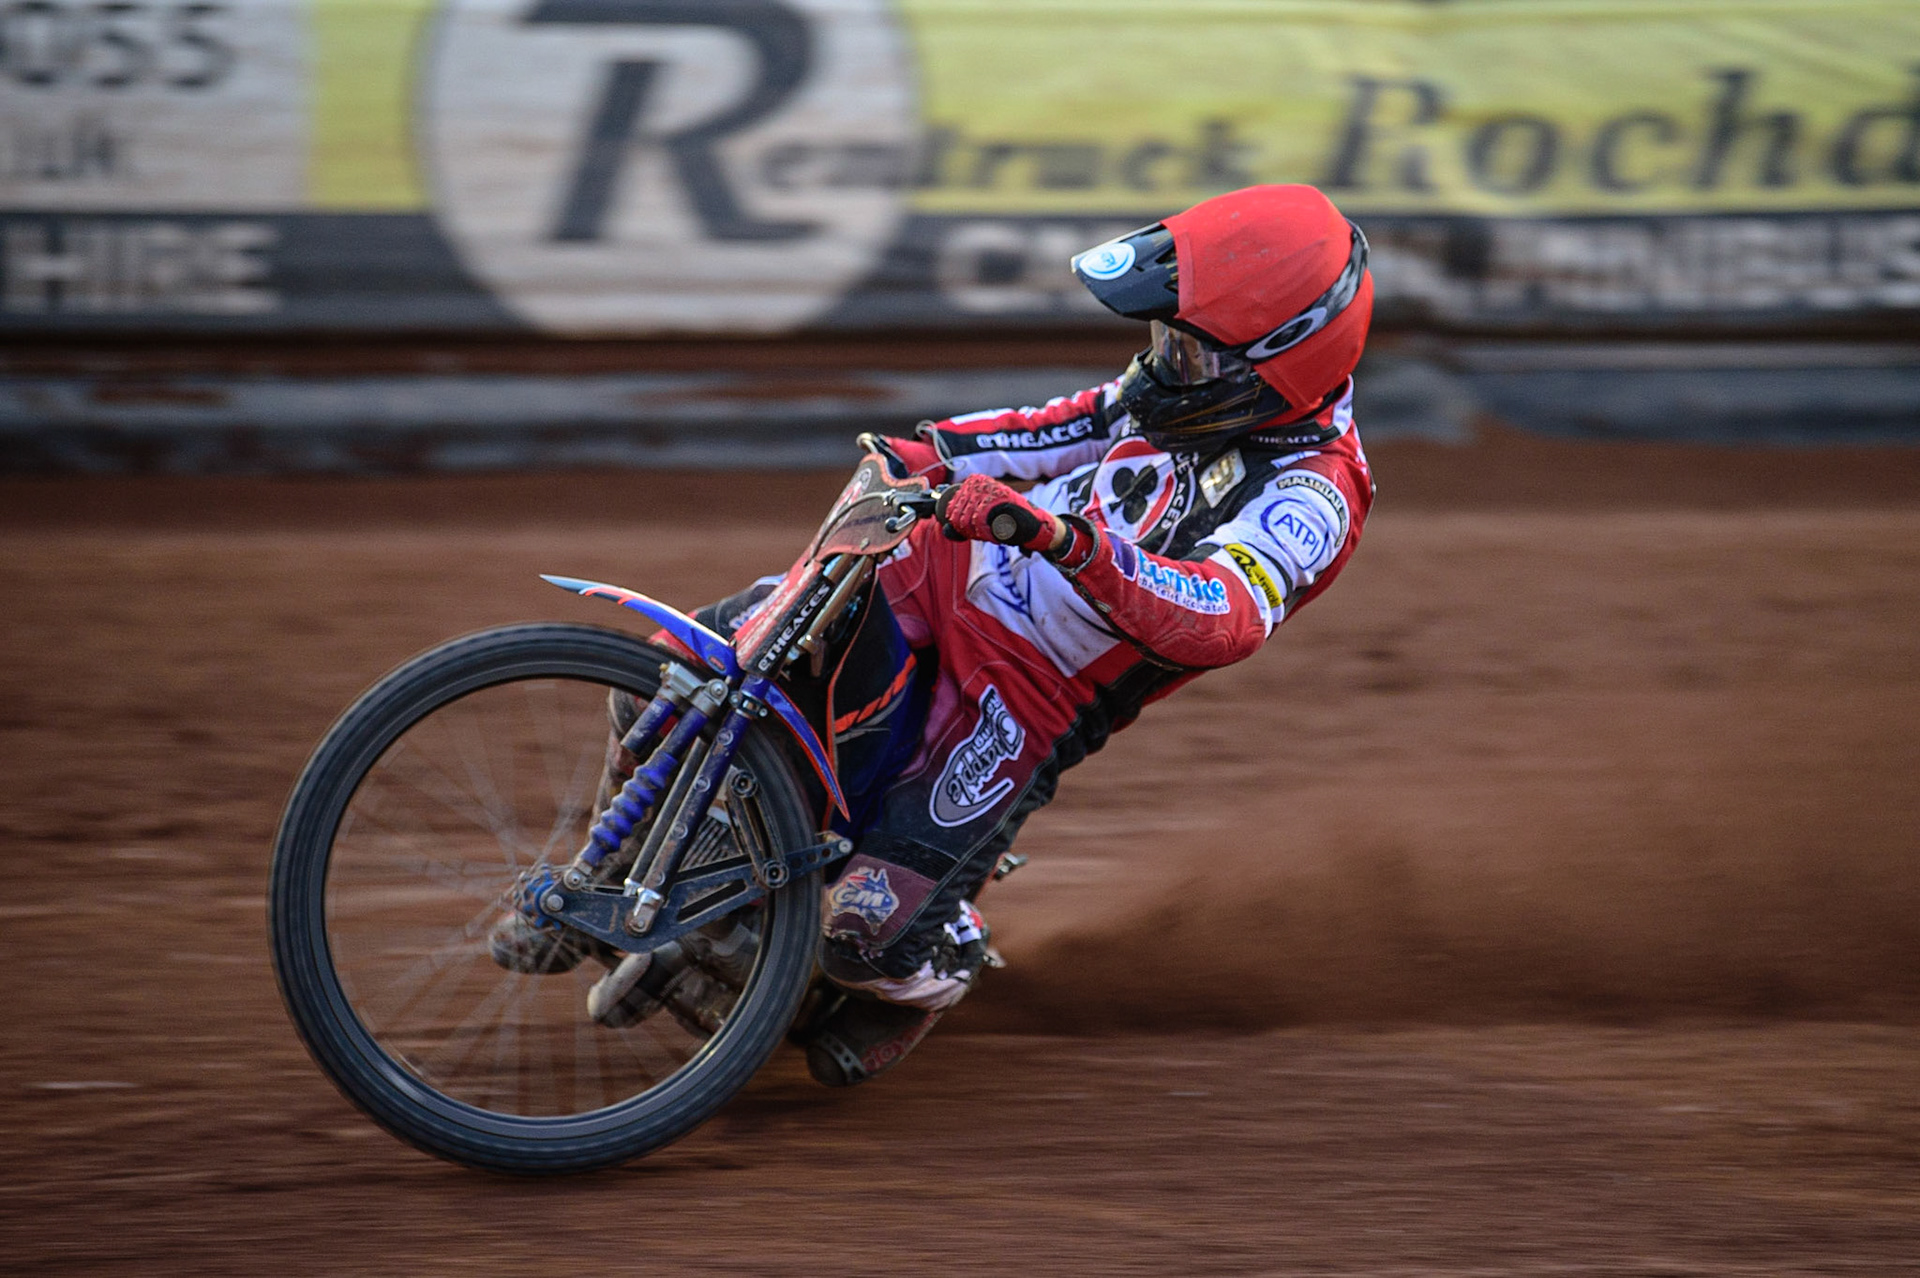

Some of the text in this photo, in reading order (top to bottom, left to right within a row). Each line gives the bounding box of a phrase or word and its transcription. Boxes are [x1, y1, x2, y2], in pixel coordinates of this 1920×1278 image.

[8, 222, 282, 315] HIRE
[1161, 481, 1187, 531] ACES
[1273, 512, 1320, 557] ATPI
[974, 693, 1004, 750] Rang
[832, 885, 885, 908] GM
